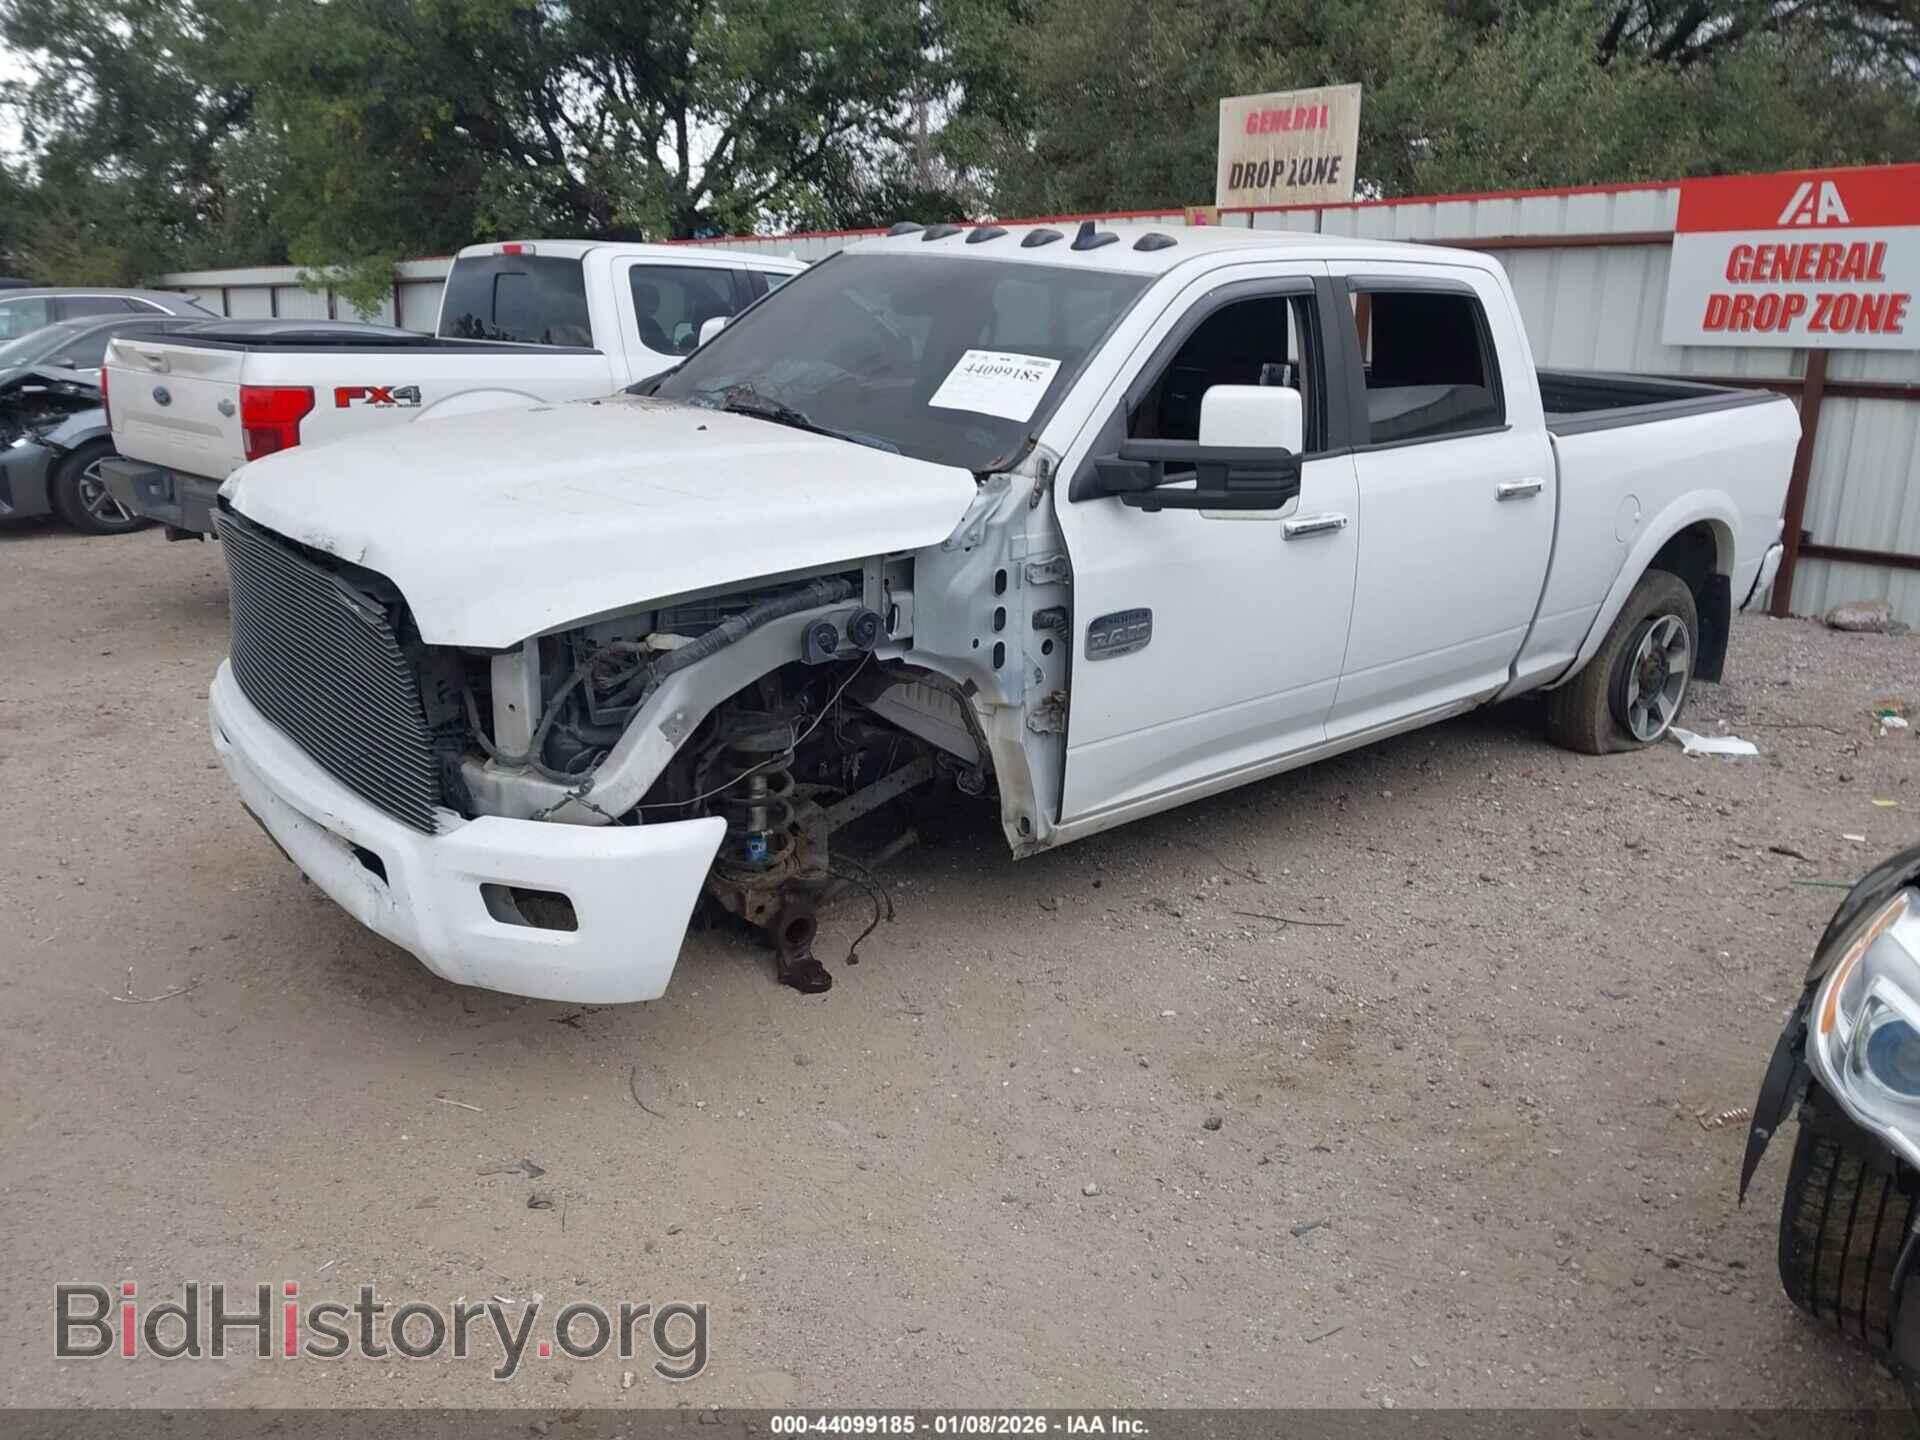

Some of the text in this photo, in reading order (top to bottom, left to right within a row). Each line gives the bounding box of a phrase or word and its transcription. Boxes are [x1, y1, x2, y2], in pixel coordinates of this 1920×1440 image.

[1246, 105, 1328, 134] GENERAL
[1228, 156, 1342, 189] DROP ZONE
[1725, 241, 1888, 284] GENERAL
[1702, 293, 1911, 333] DROP ZONE
[964, 363, 1043, 382] 44099185
[334, 385, 422, 408] FX4
